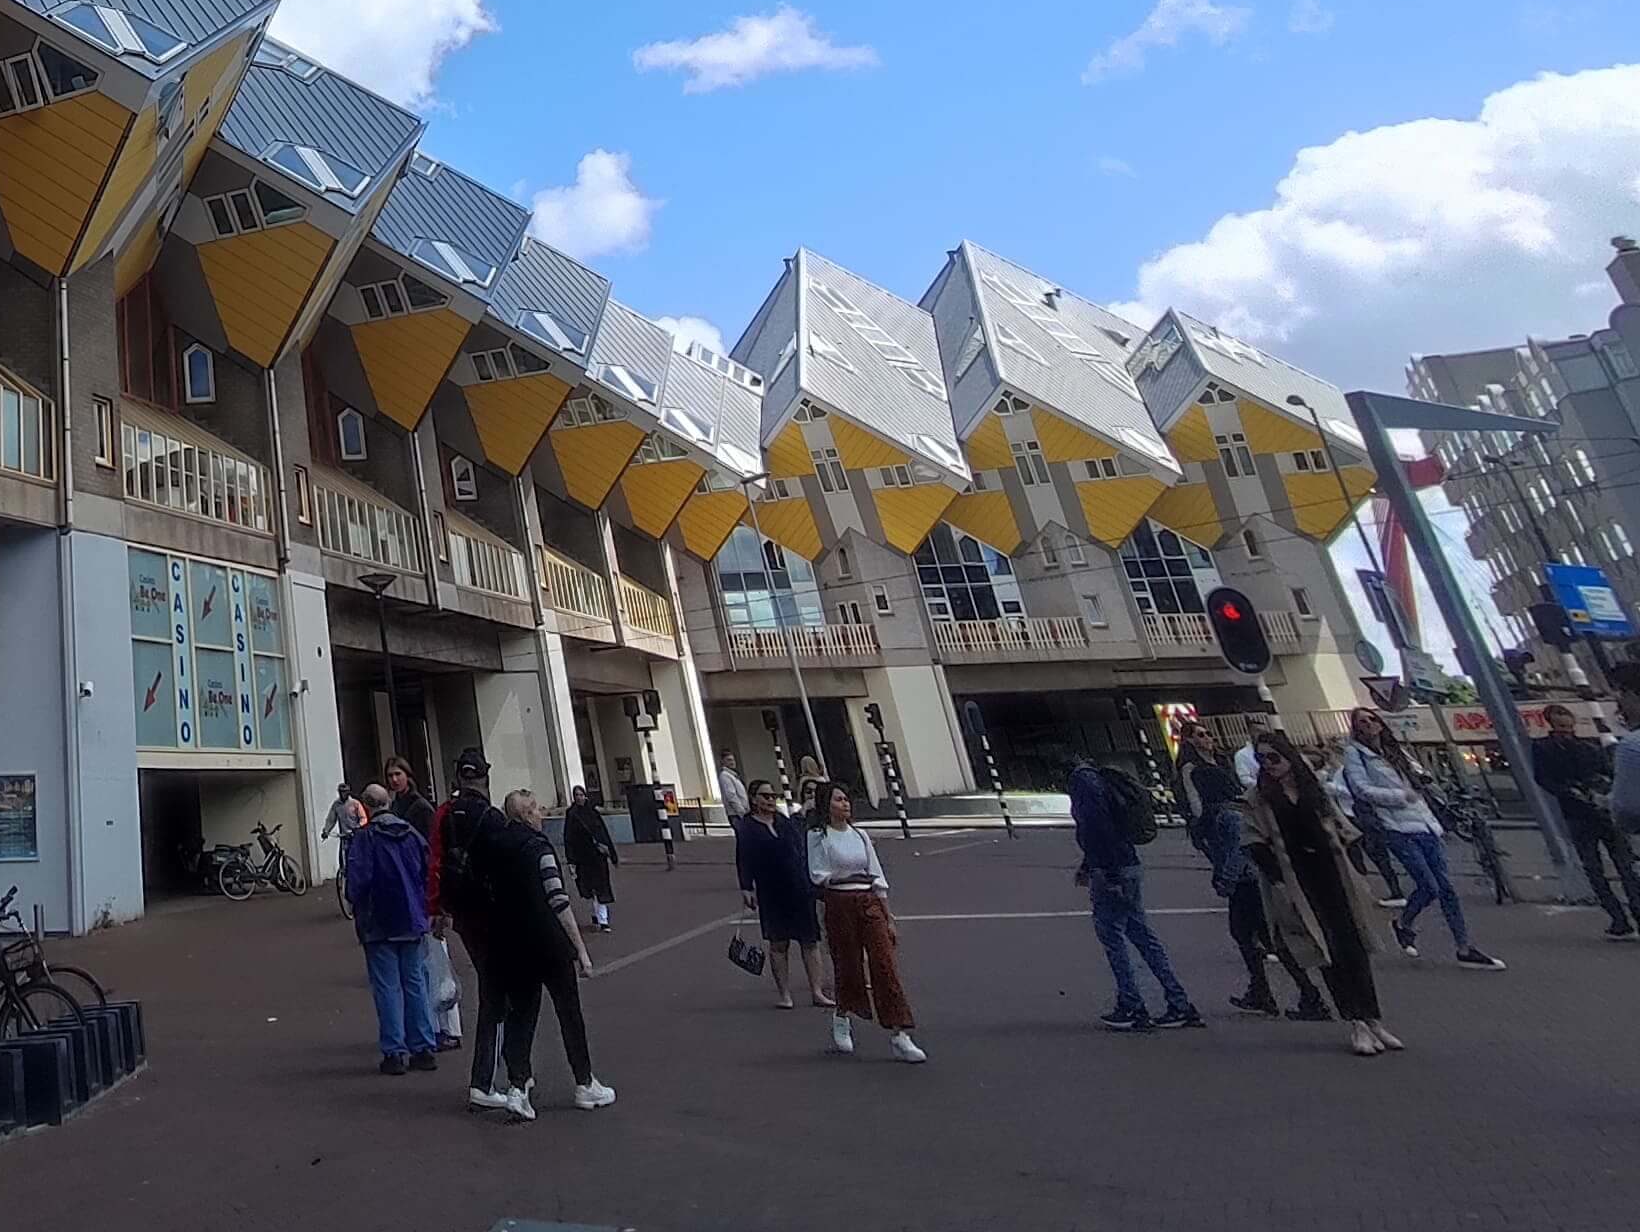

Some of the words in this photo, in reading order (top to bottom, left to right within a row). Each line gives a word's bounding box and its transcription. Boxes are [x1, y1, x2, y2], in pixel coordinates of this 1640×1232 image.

[140, 585, 150, 599] Be
[151, 587, 166, 602] One
[171, 561, 191, 744] CASINO
[208, 689, 218, 705] Be
[218, 691, 233, 706] One
[231, 574, 253, 745] CASINO
